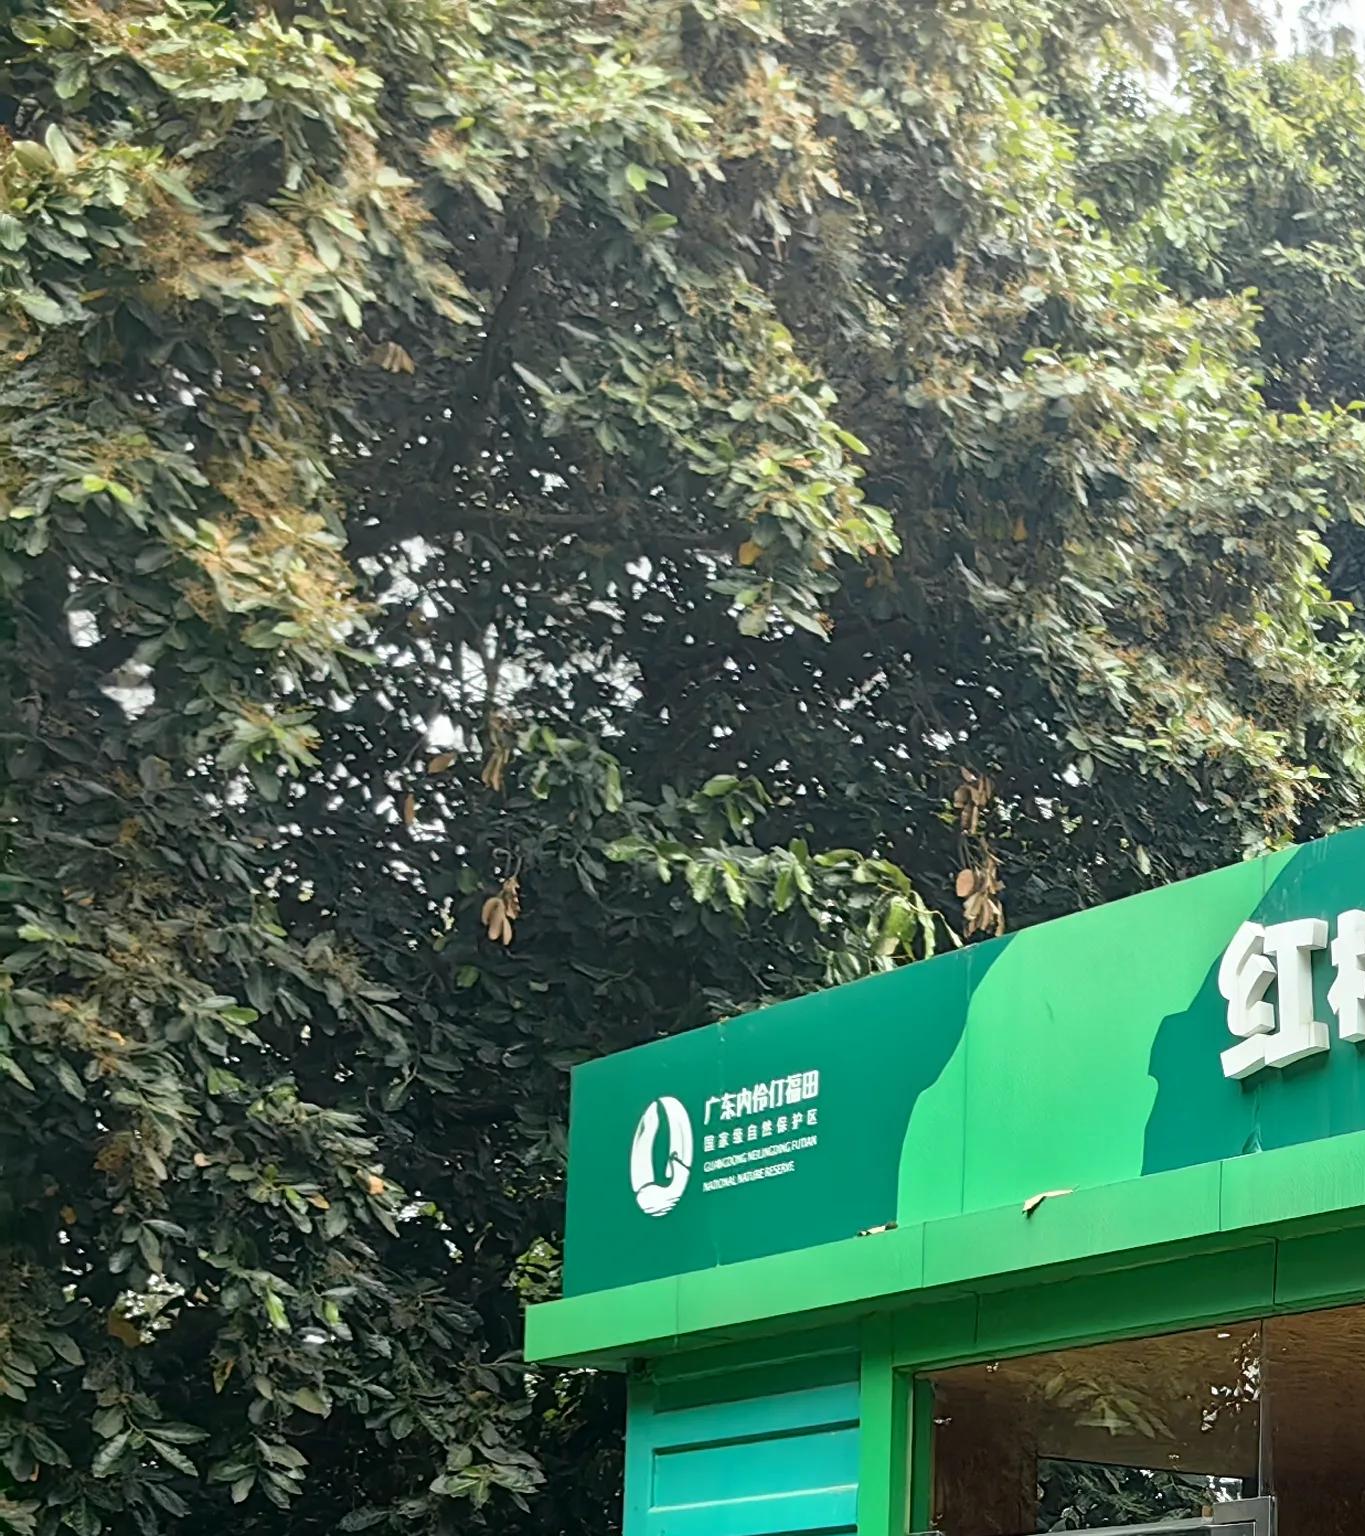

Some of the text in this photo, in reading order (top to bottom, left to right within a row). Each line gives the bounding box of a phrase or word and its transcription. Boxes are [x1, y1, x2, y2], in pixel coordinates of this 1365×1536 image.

[704, 1070, 819, 1126] 广东内伶仃福田
[704, 1108, 819, 1153] 国家级自然保护区
